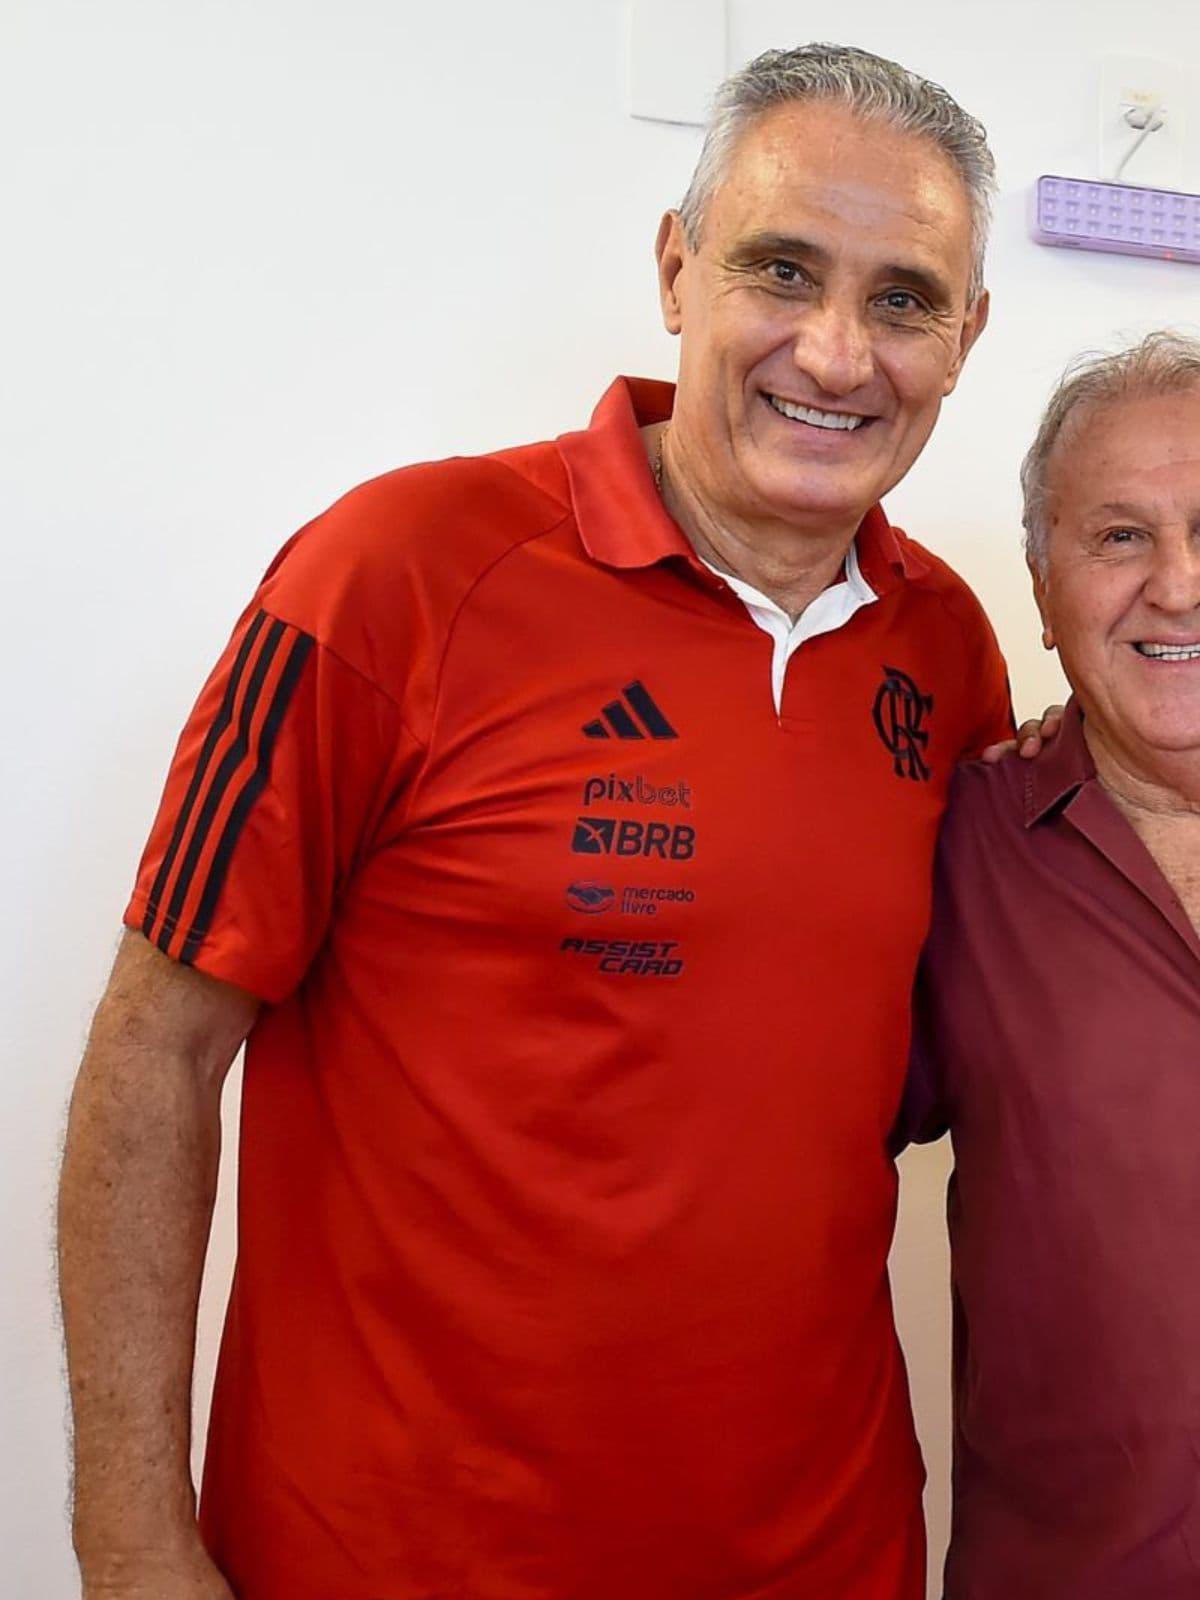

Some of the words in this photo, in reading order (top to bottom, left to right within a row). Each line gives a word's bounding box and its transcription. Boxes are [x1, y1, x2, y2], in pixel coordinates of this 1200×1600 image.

[583, 772, 691, 808] pixbet
[616, 820, 696, 860] BRB
[623, 887, 695, 903] mercado
[620, 901, 657, 915] livre
[560, 937, 679, 958] ASSIST
[599, 957, 684, 976] CARD
